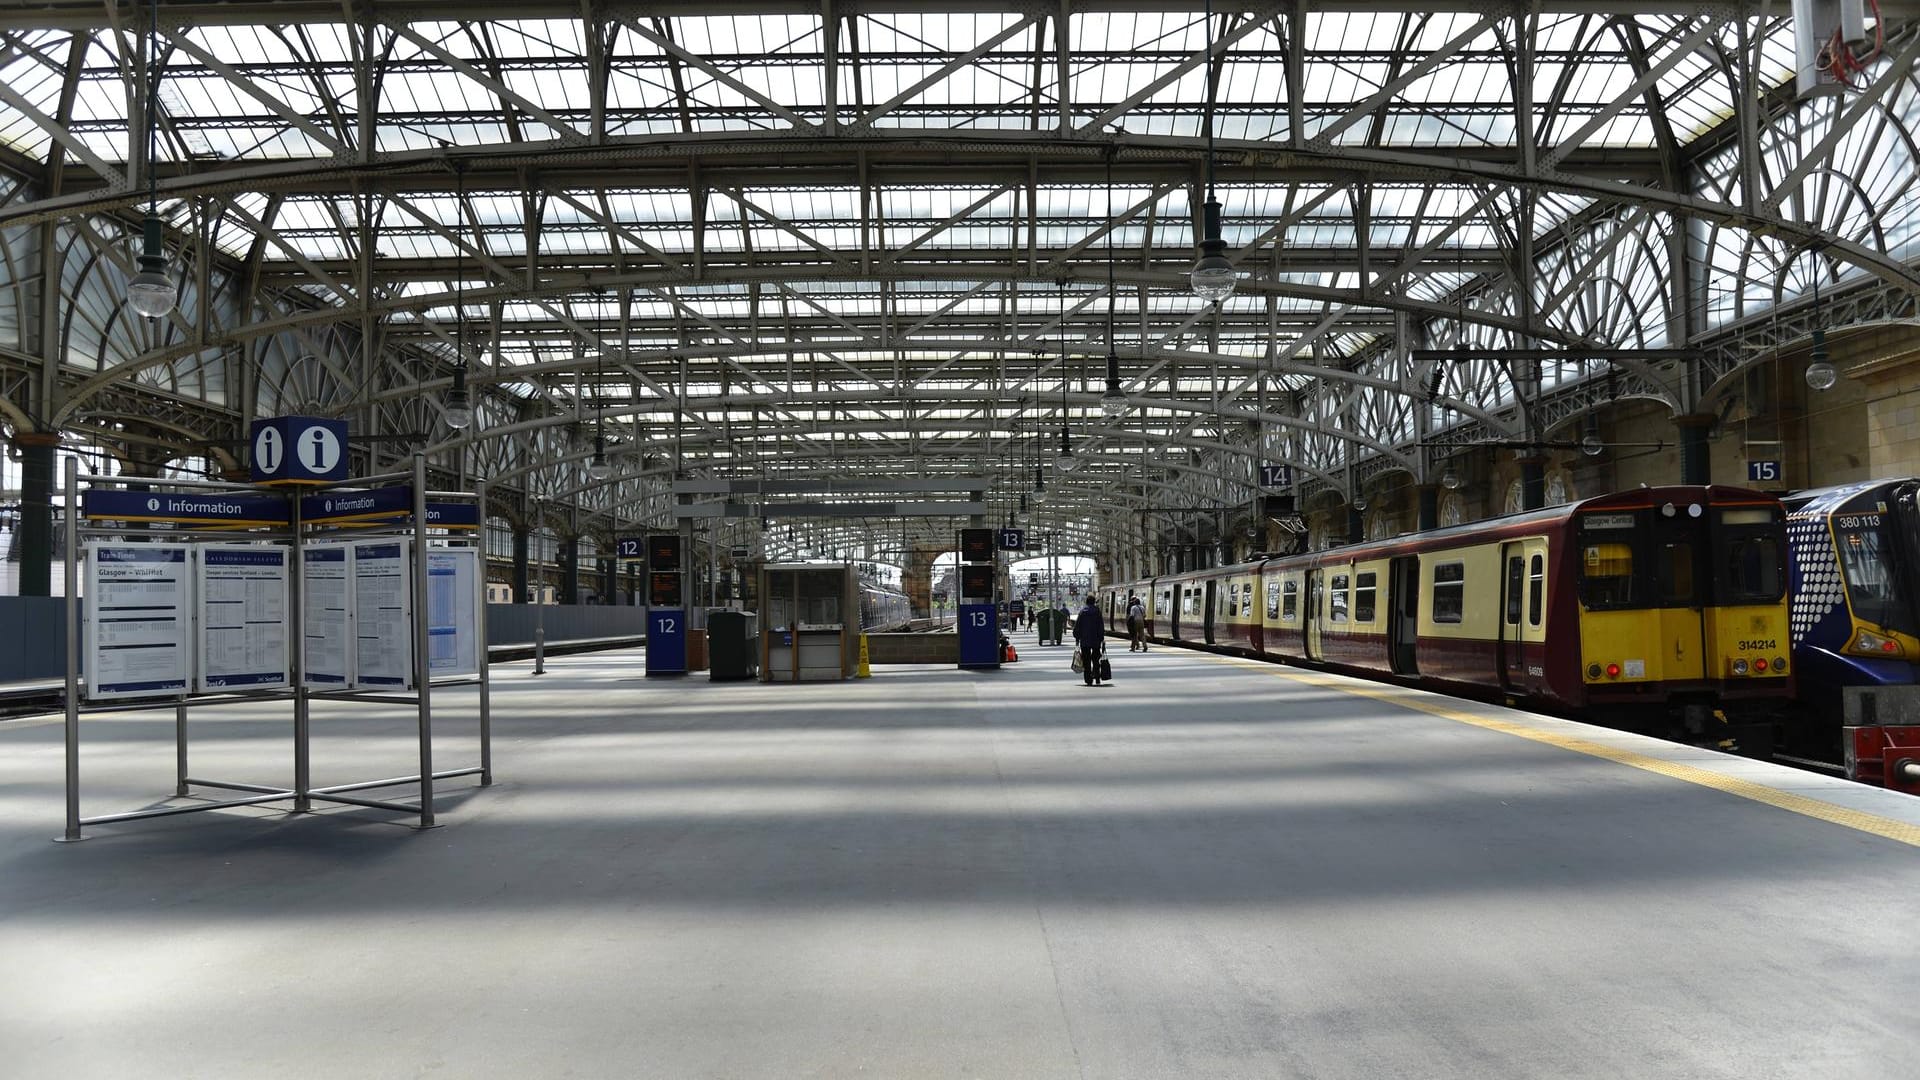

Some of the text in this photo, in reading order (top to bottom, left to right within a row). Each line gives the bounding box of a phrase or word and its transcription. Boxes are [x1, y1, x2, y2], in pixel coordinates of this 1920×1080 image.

[1263, 467, 1288, 486] 14
[1753, 462, 1775, 481] 15
[168, 499, 242, 514] Information
[335, 497, 375, 511] Information
[1840, 515, 1881, 529] 380 113
[1003, 533, 1018, 547] 13
[622, 541, 638, 555] 12
[99, 568, 126, 577] Glasgow
[658, 618, 675, 633] 12
[970, 611, 987, 627] 13
[1738, 639, 1777, 651] 314214
